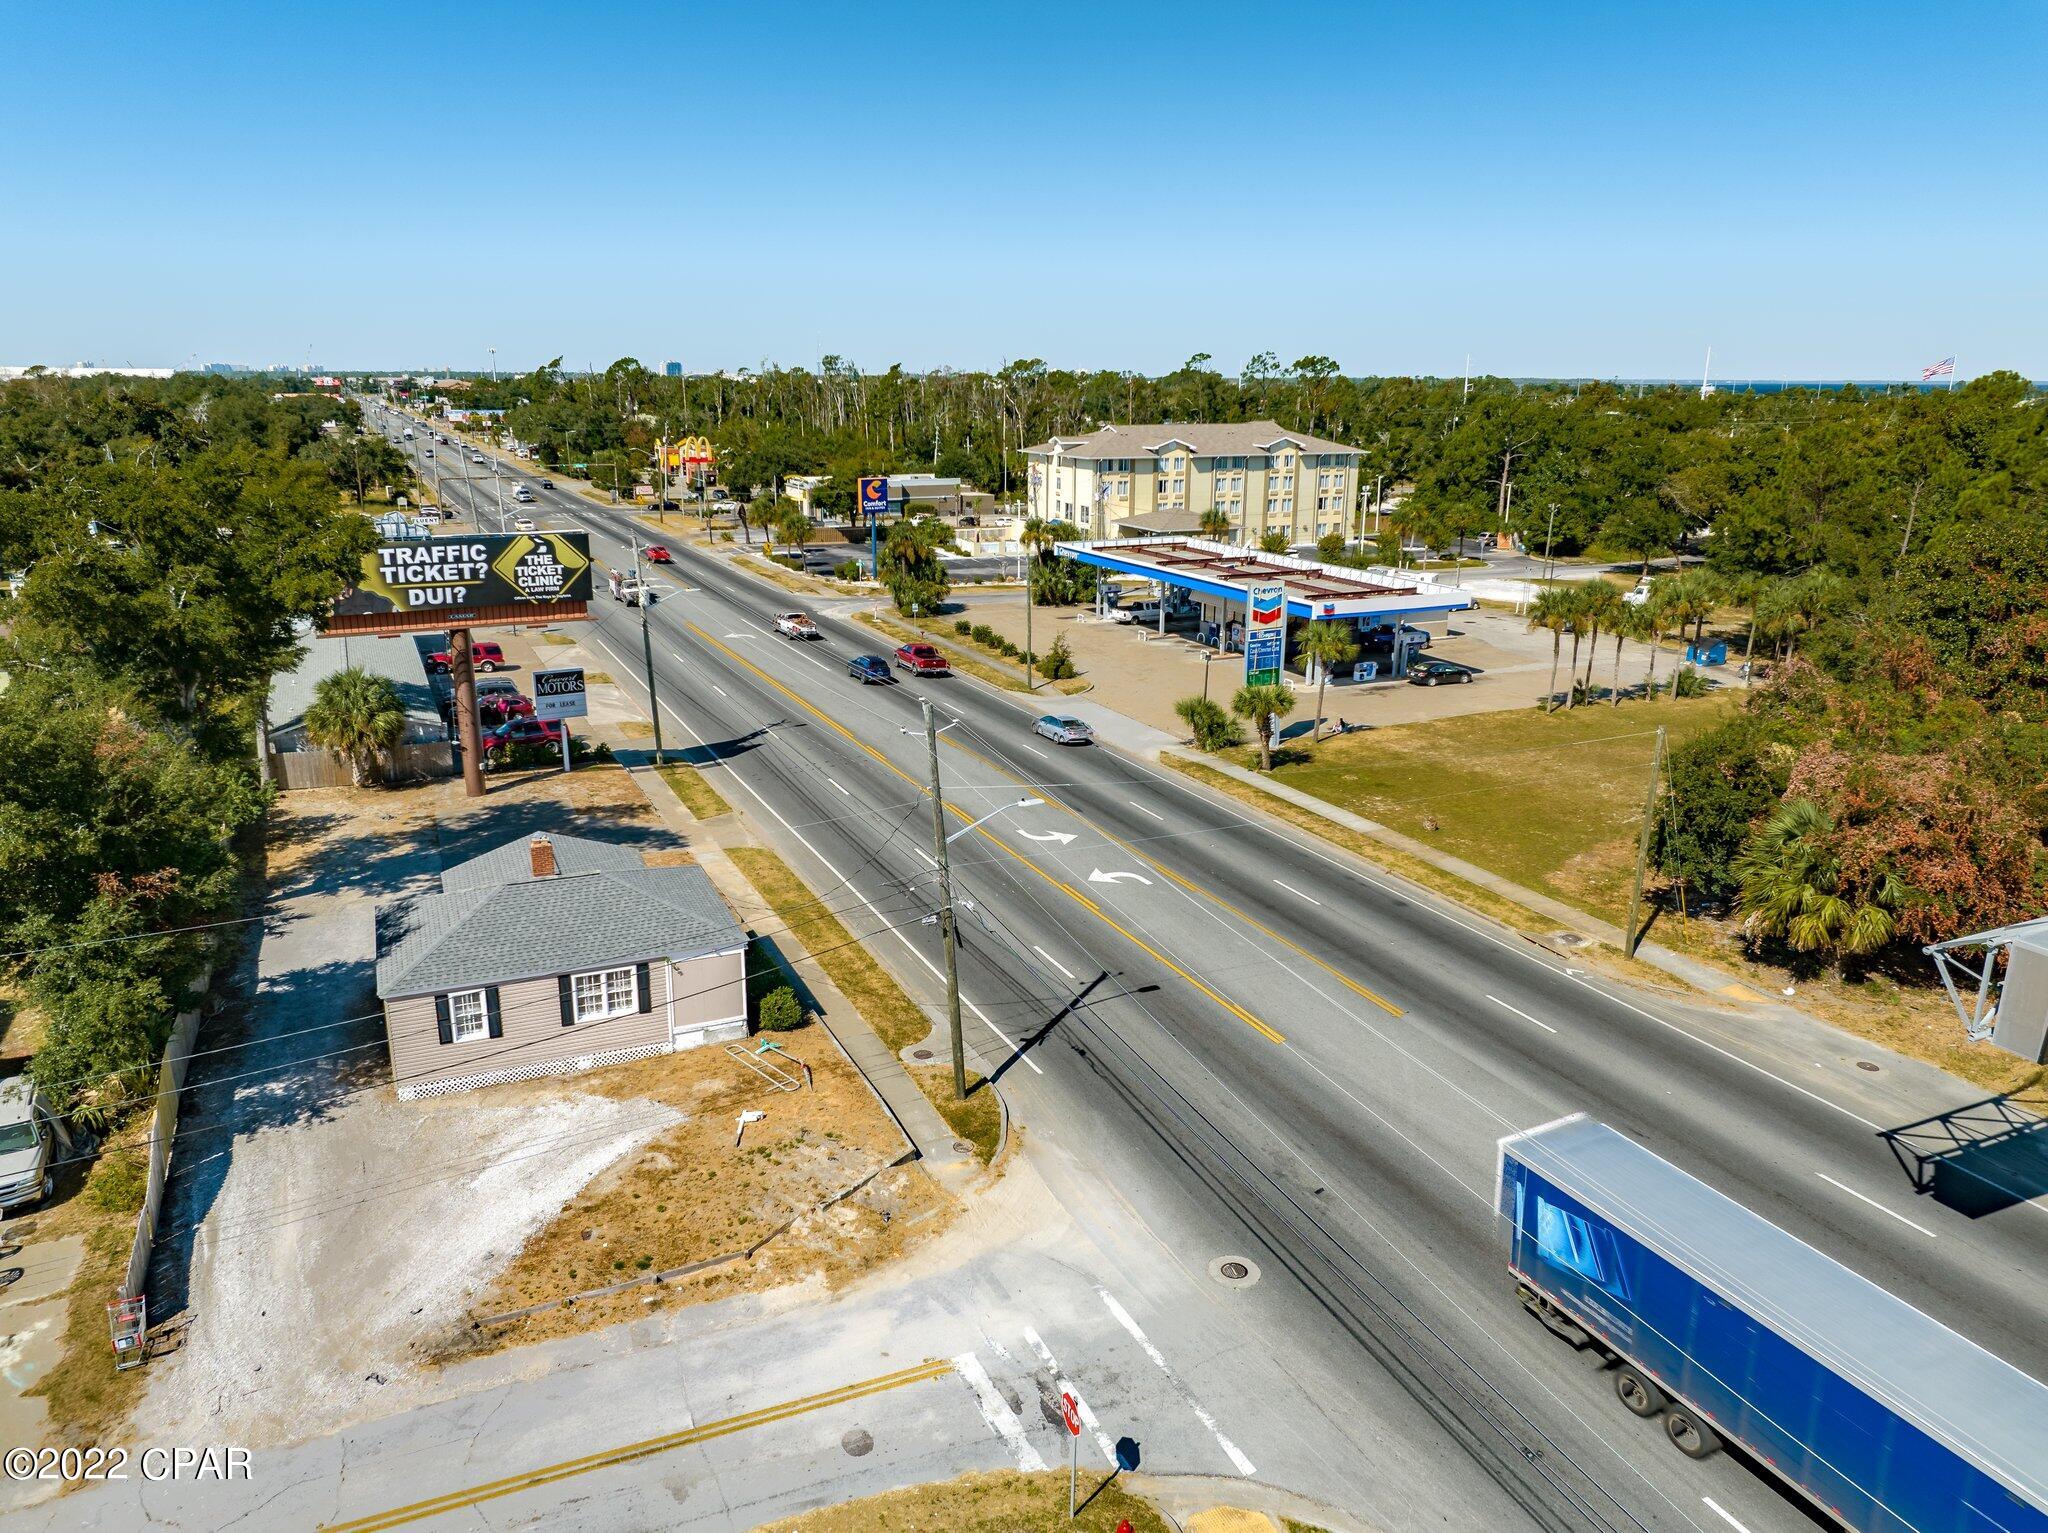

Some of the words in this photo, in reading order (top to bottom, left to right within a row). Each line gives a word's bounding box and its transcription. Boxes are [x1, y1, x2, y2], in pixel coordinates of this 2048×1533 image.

[377, 544, 488, 565] TRAFFIC
[524, 554, 553, 565] THE
[379, 562, 489, 584] TICKET?
[515, 565, 564, 577] TICKET
[518, 575, 563, 587] CLINIC
[408, 586, 467, 606] DUI?
[1253, 587, 1283, 595] Chevron
[537, 680, 584, 694] MOTORS
[1062, 1397, 1080, 1428] STOP
